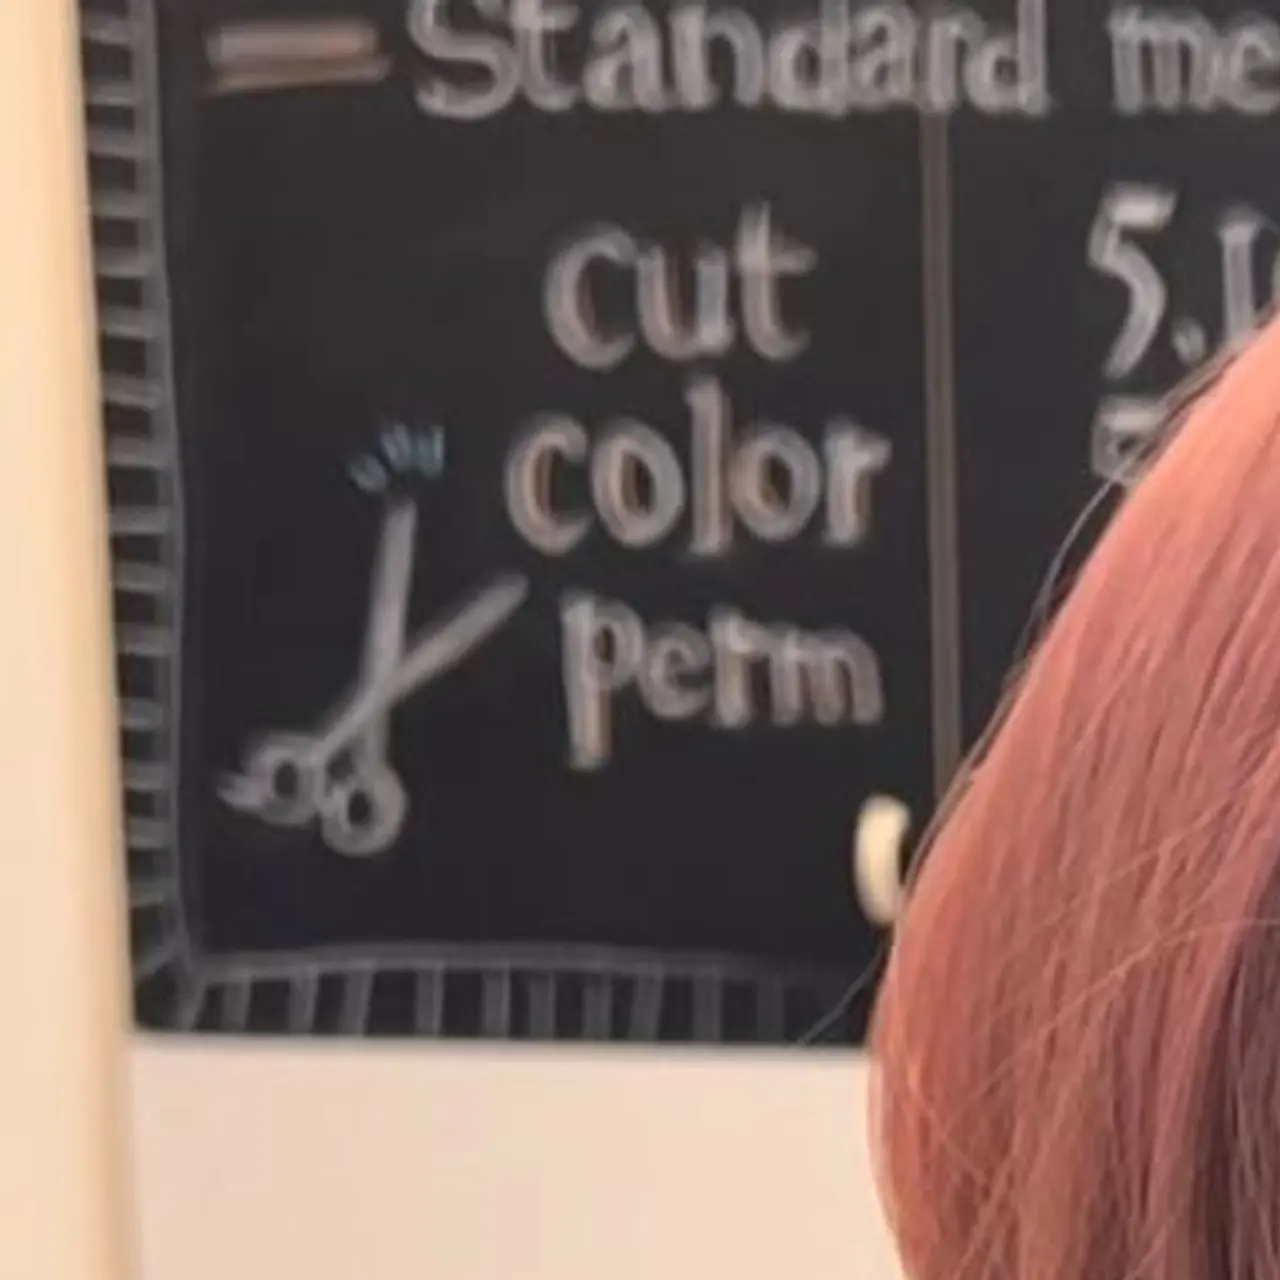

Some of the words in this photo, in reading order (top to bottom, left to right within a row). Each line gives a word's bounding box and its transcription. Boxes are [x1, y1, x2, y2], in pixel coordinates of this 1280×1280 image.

[405, 0, 1050, 118] Standard
[543, 202, 816, 370] cut
[506, 376, 890, 556] color
[560, 594, 885, 770] perm
